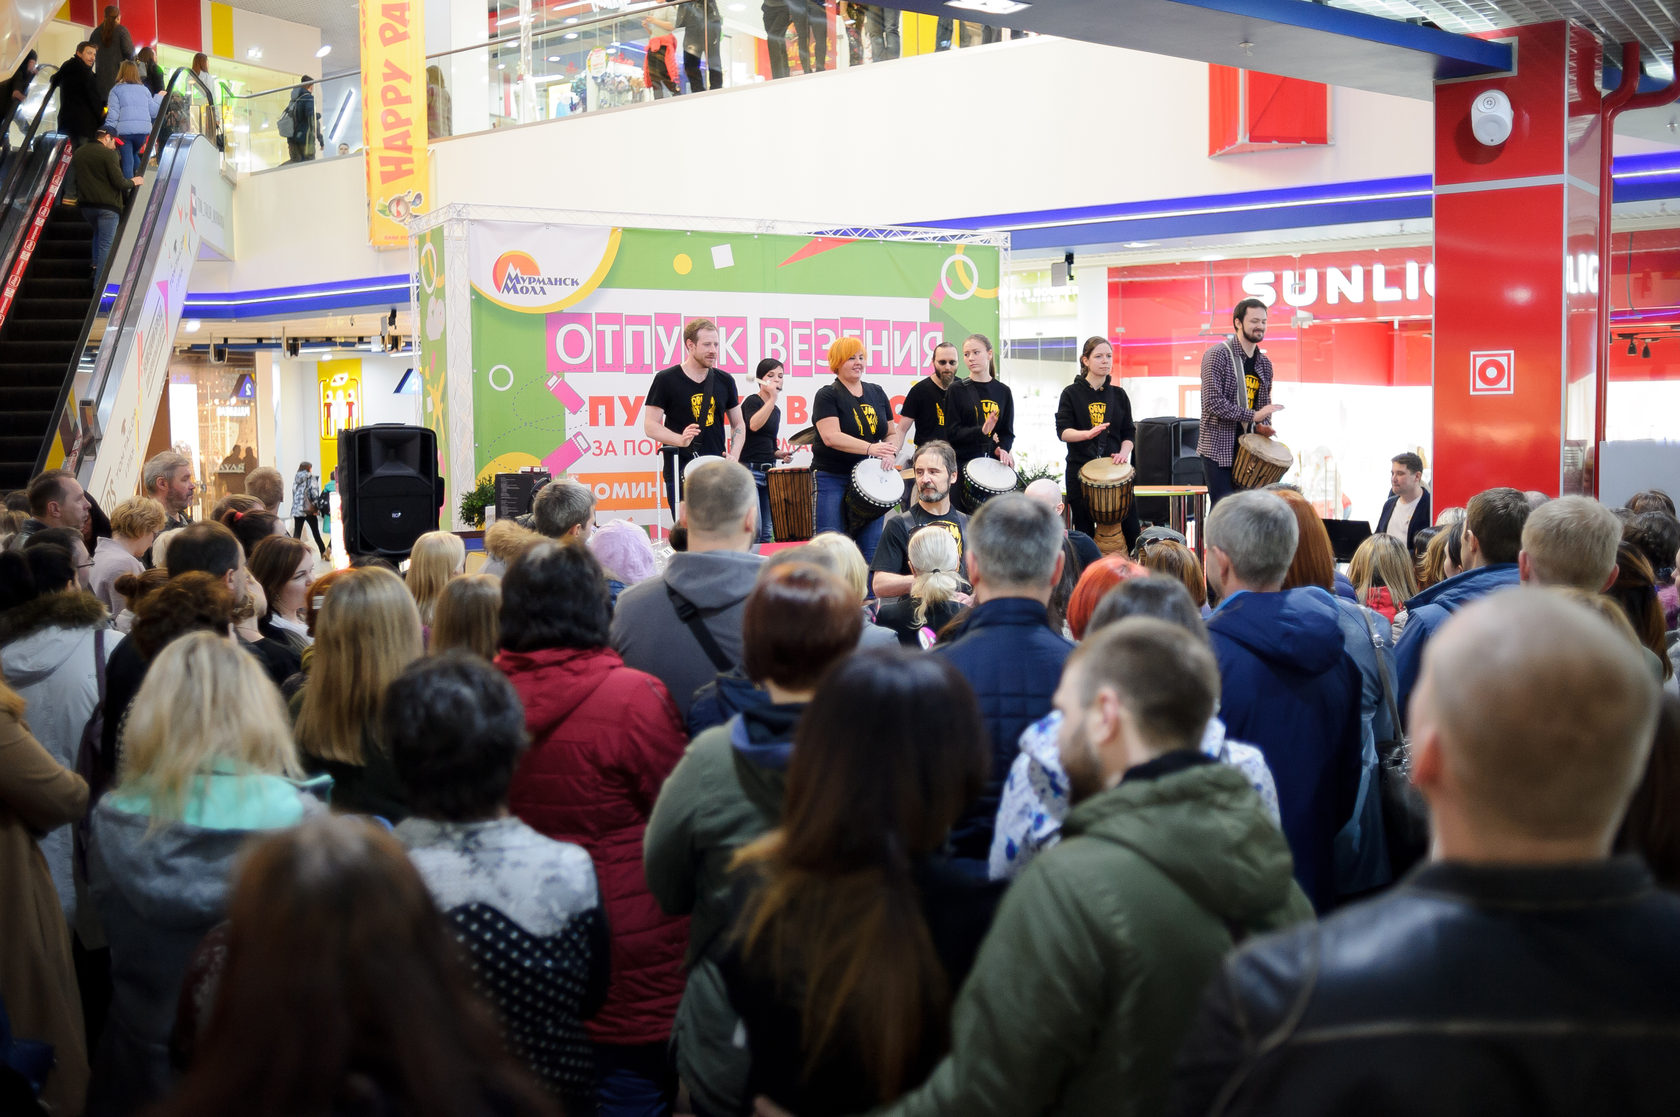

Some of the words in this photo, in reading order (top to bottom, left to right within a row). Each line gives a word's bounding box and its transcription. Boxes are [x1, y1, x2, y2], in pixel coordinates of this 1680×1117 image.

[379, 58, 414, 184] HAPPY
[555, 322, 745, 366] ОТПУК
[763, 326, 943, 369] ВЕЗНИЯ
[592, 439, 618, 457] ЗА
